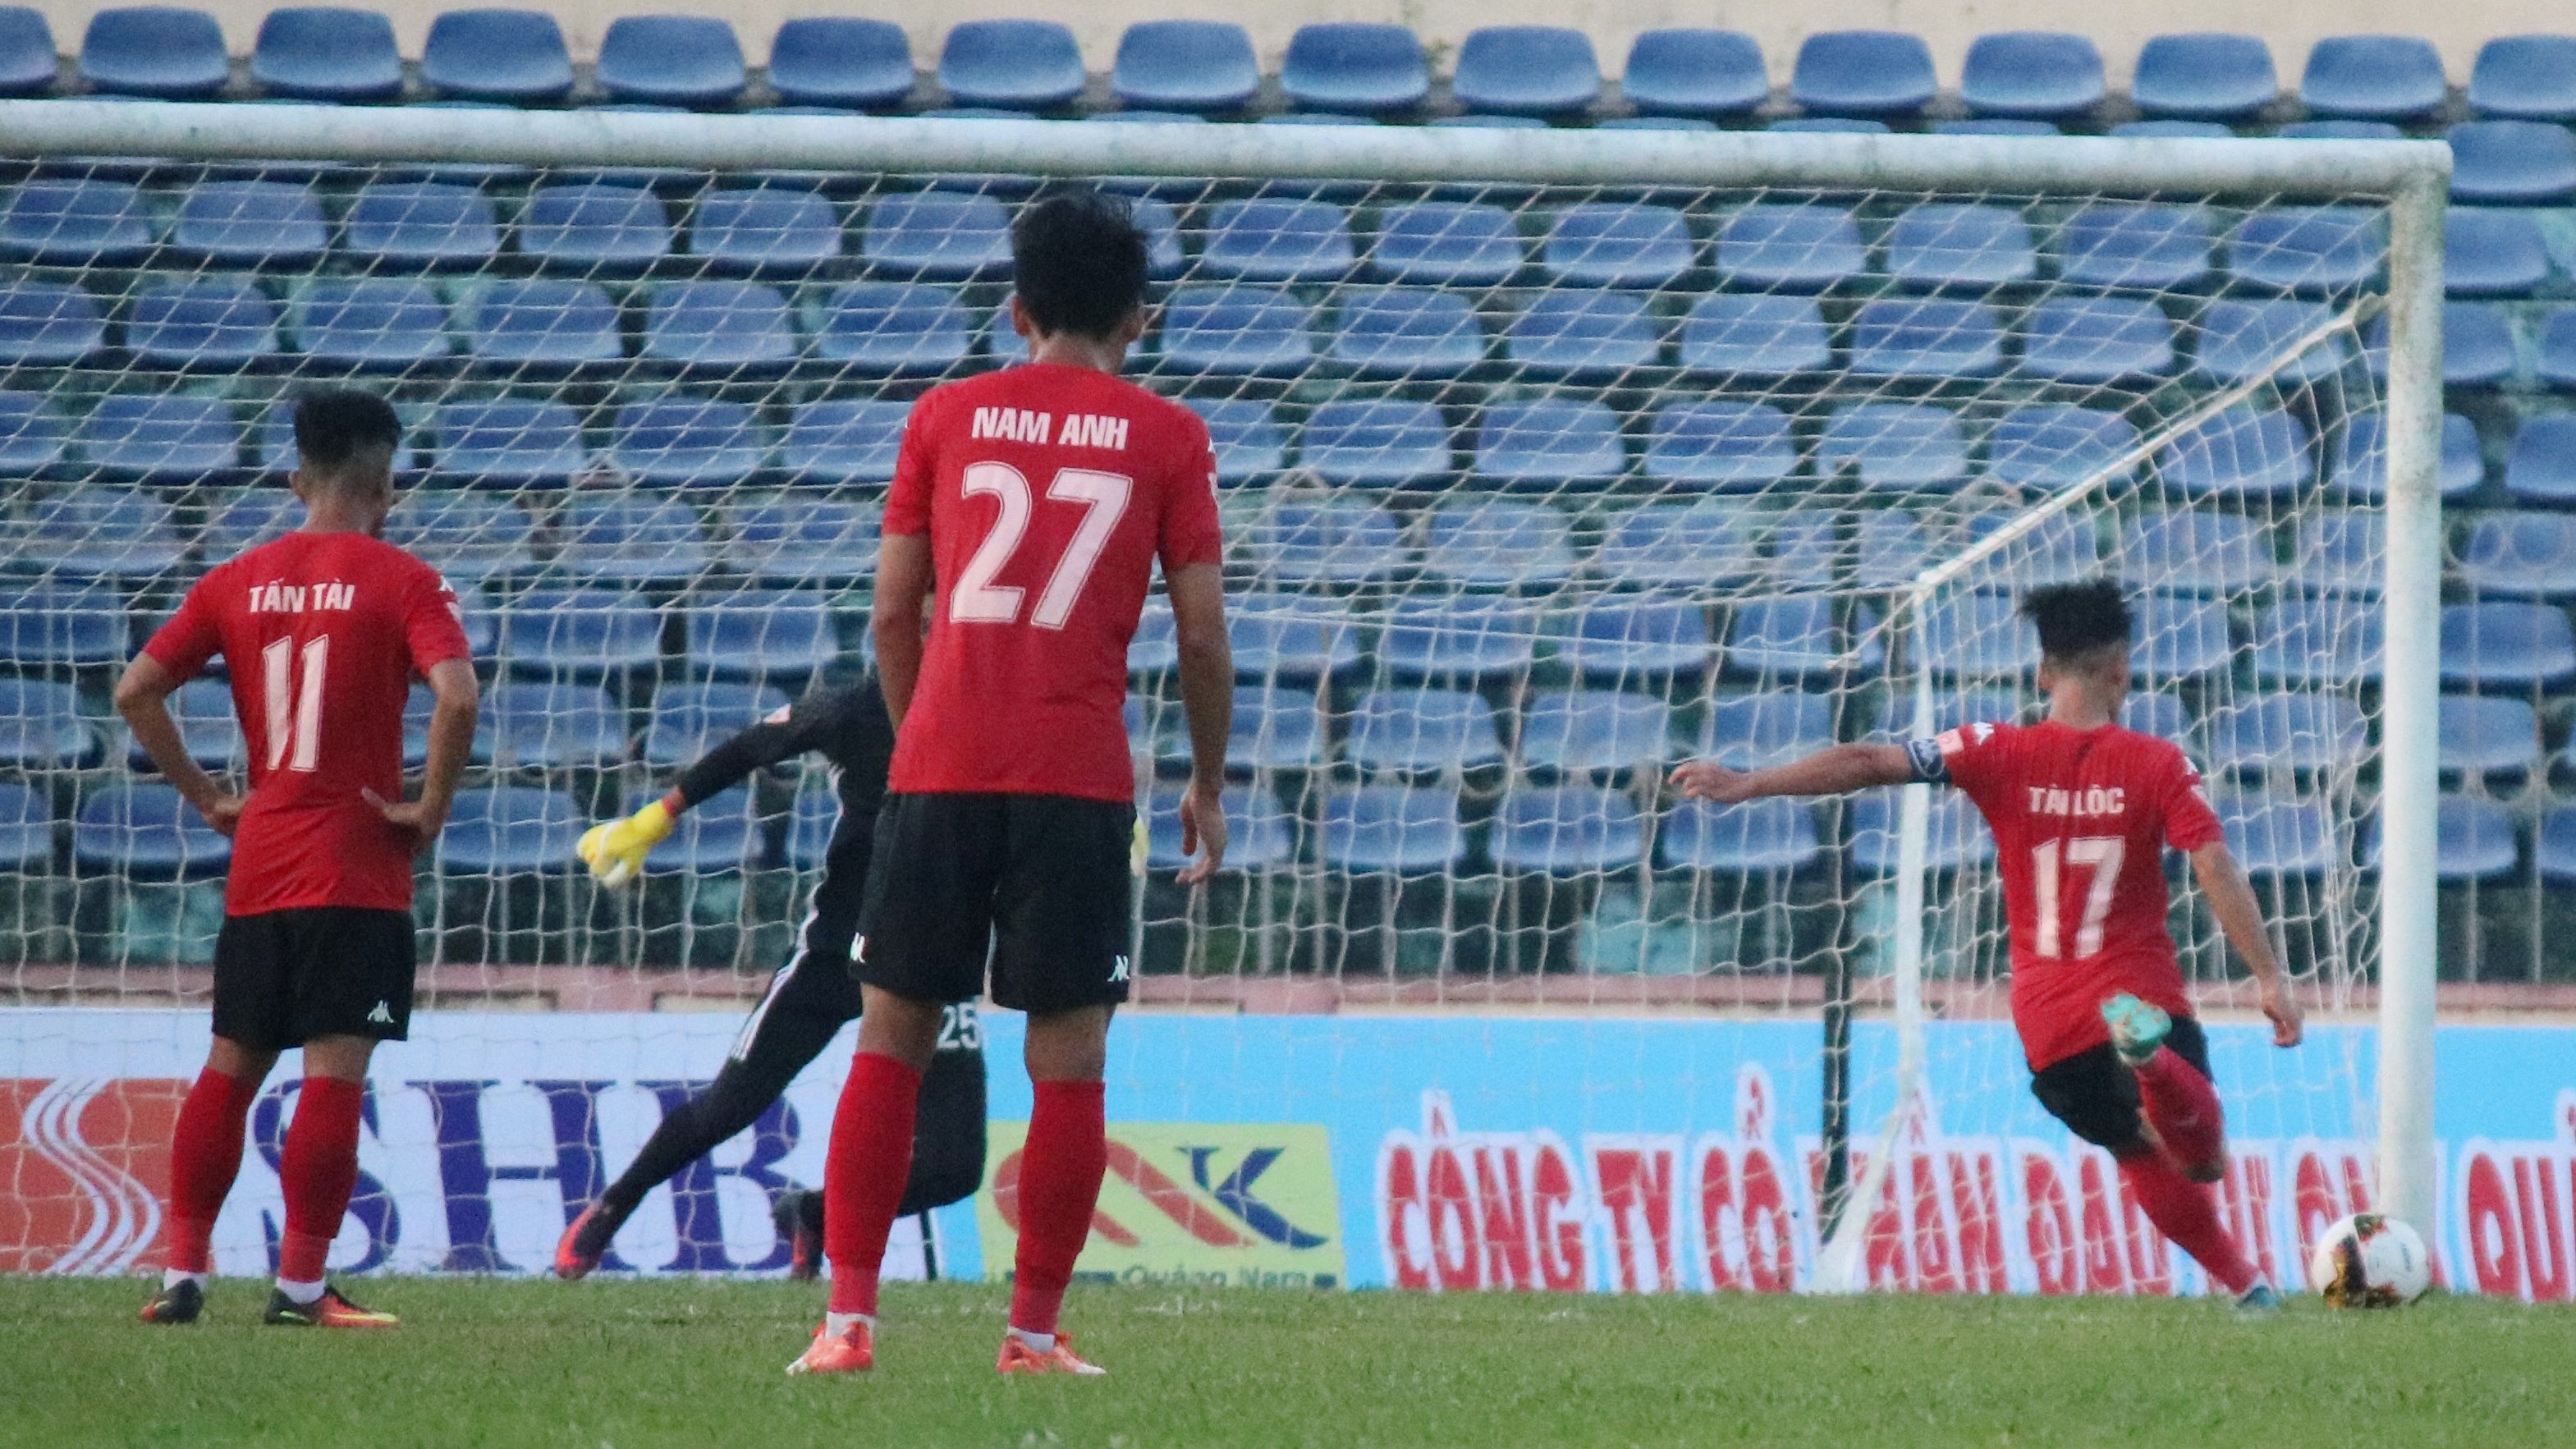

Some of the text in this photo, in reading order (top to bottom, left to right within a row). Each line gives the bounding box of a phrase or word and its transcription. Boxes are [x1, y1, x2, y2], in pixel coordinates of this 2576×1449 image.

[971, 407, 1130, 451] NAM ANH
[950, 461, 1134, 630] 27
[312, 577, 355, 611] TÀI
[263, 634, 329, 772] 11
[2073, 784, 2125, 819] LỘC
[2033, 836, 2125, 960] 17
[937, 1002, 982, 1049] 25
[254, 1079, 804, 1272] SHB
[1387, 1106, 1585, 1291] CÔNG
[1597, 1149, 1672, 1292] TY
[1703, 1076, 1795, 1294] CỔ
[2468, 1103, 2576, 1302] QU
[1240, 1266, 1308, 1289] Nam
